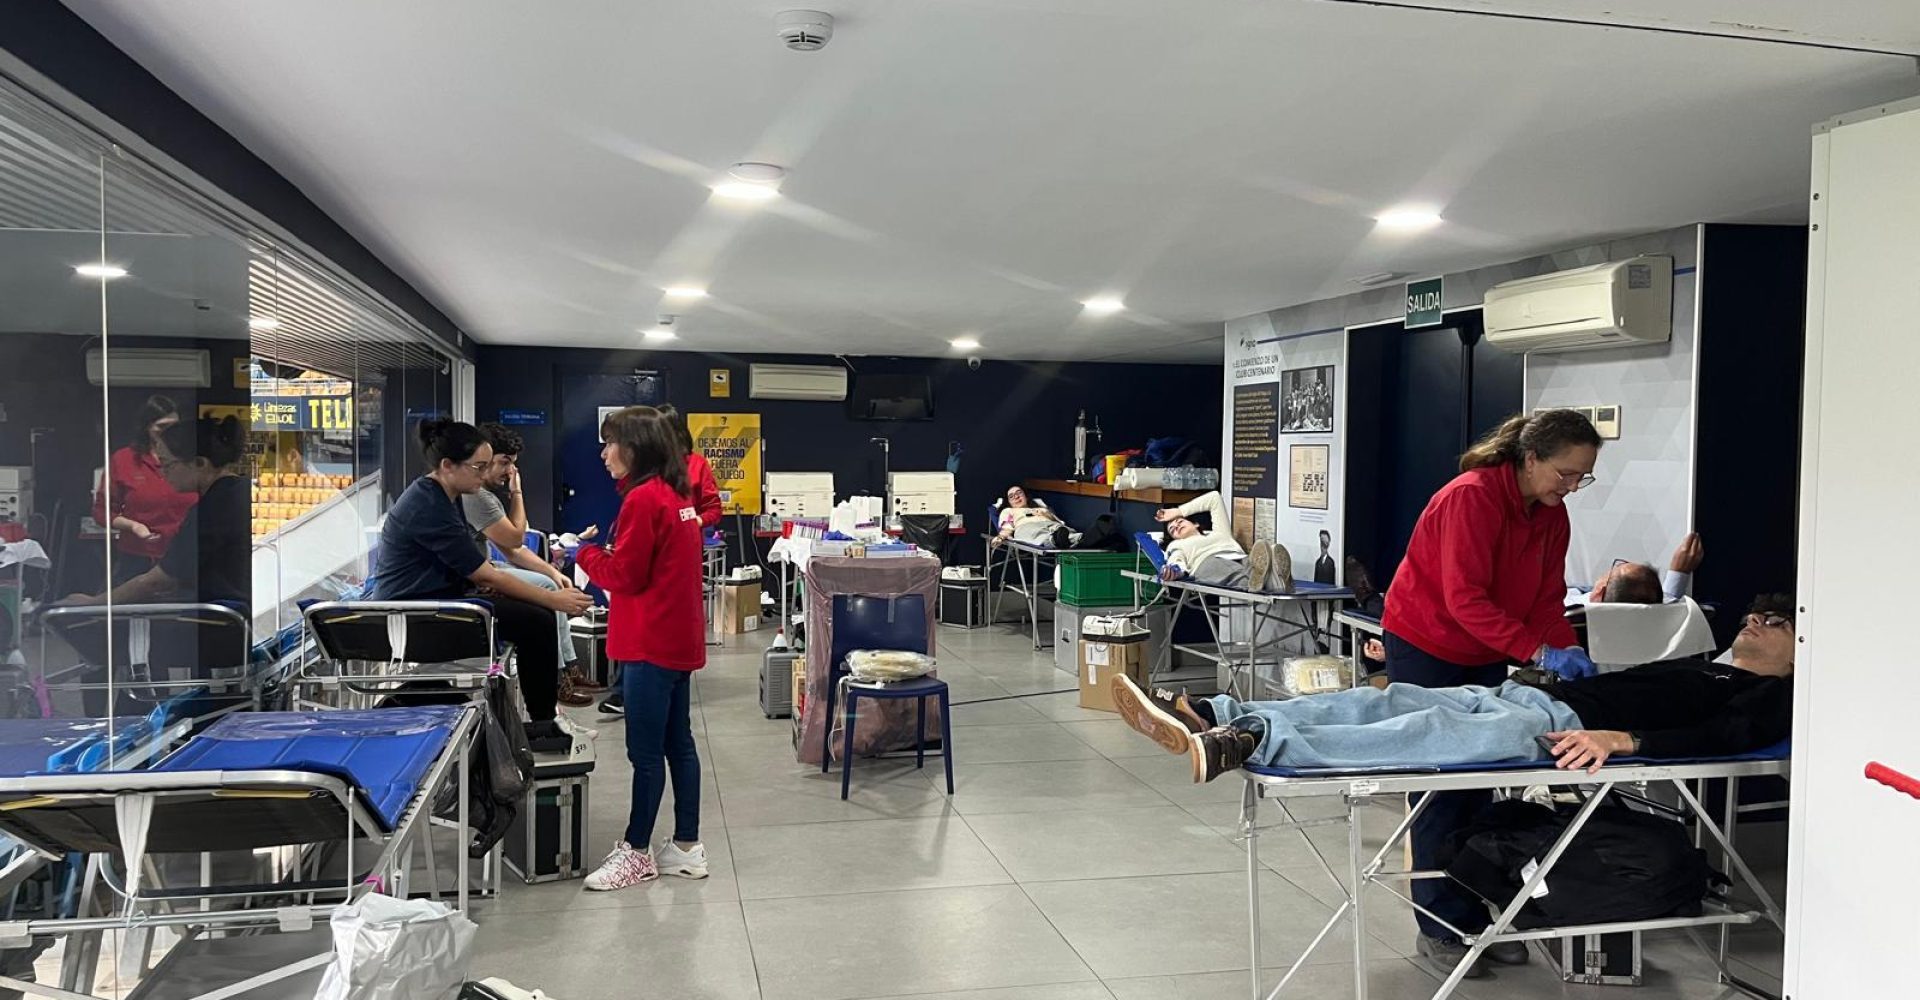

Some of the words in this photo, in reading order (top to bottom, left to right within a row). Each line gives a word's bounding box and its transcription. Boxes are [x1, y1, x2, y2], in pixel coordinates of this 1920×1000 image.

[1408, 291, 1440, 313] SALIDA
[698, 438, 738, 448] DEJEMOS
[704, 448, 745, 458] RACISMO
[711, 459, 738, 469] FUERA
[719, 469, 745, 480] JUEGO
